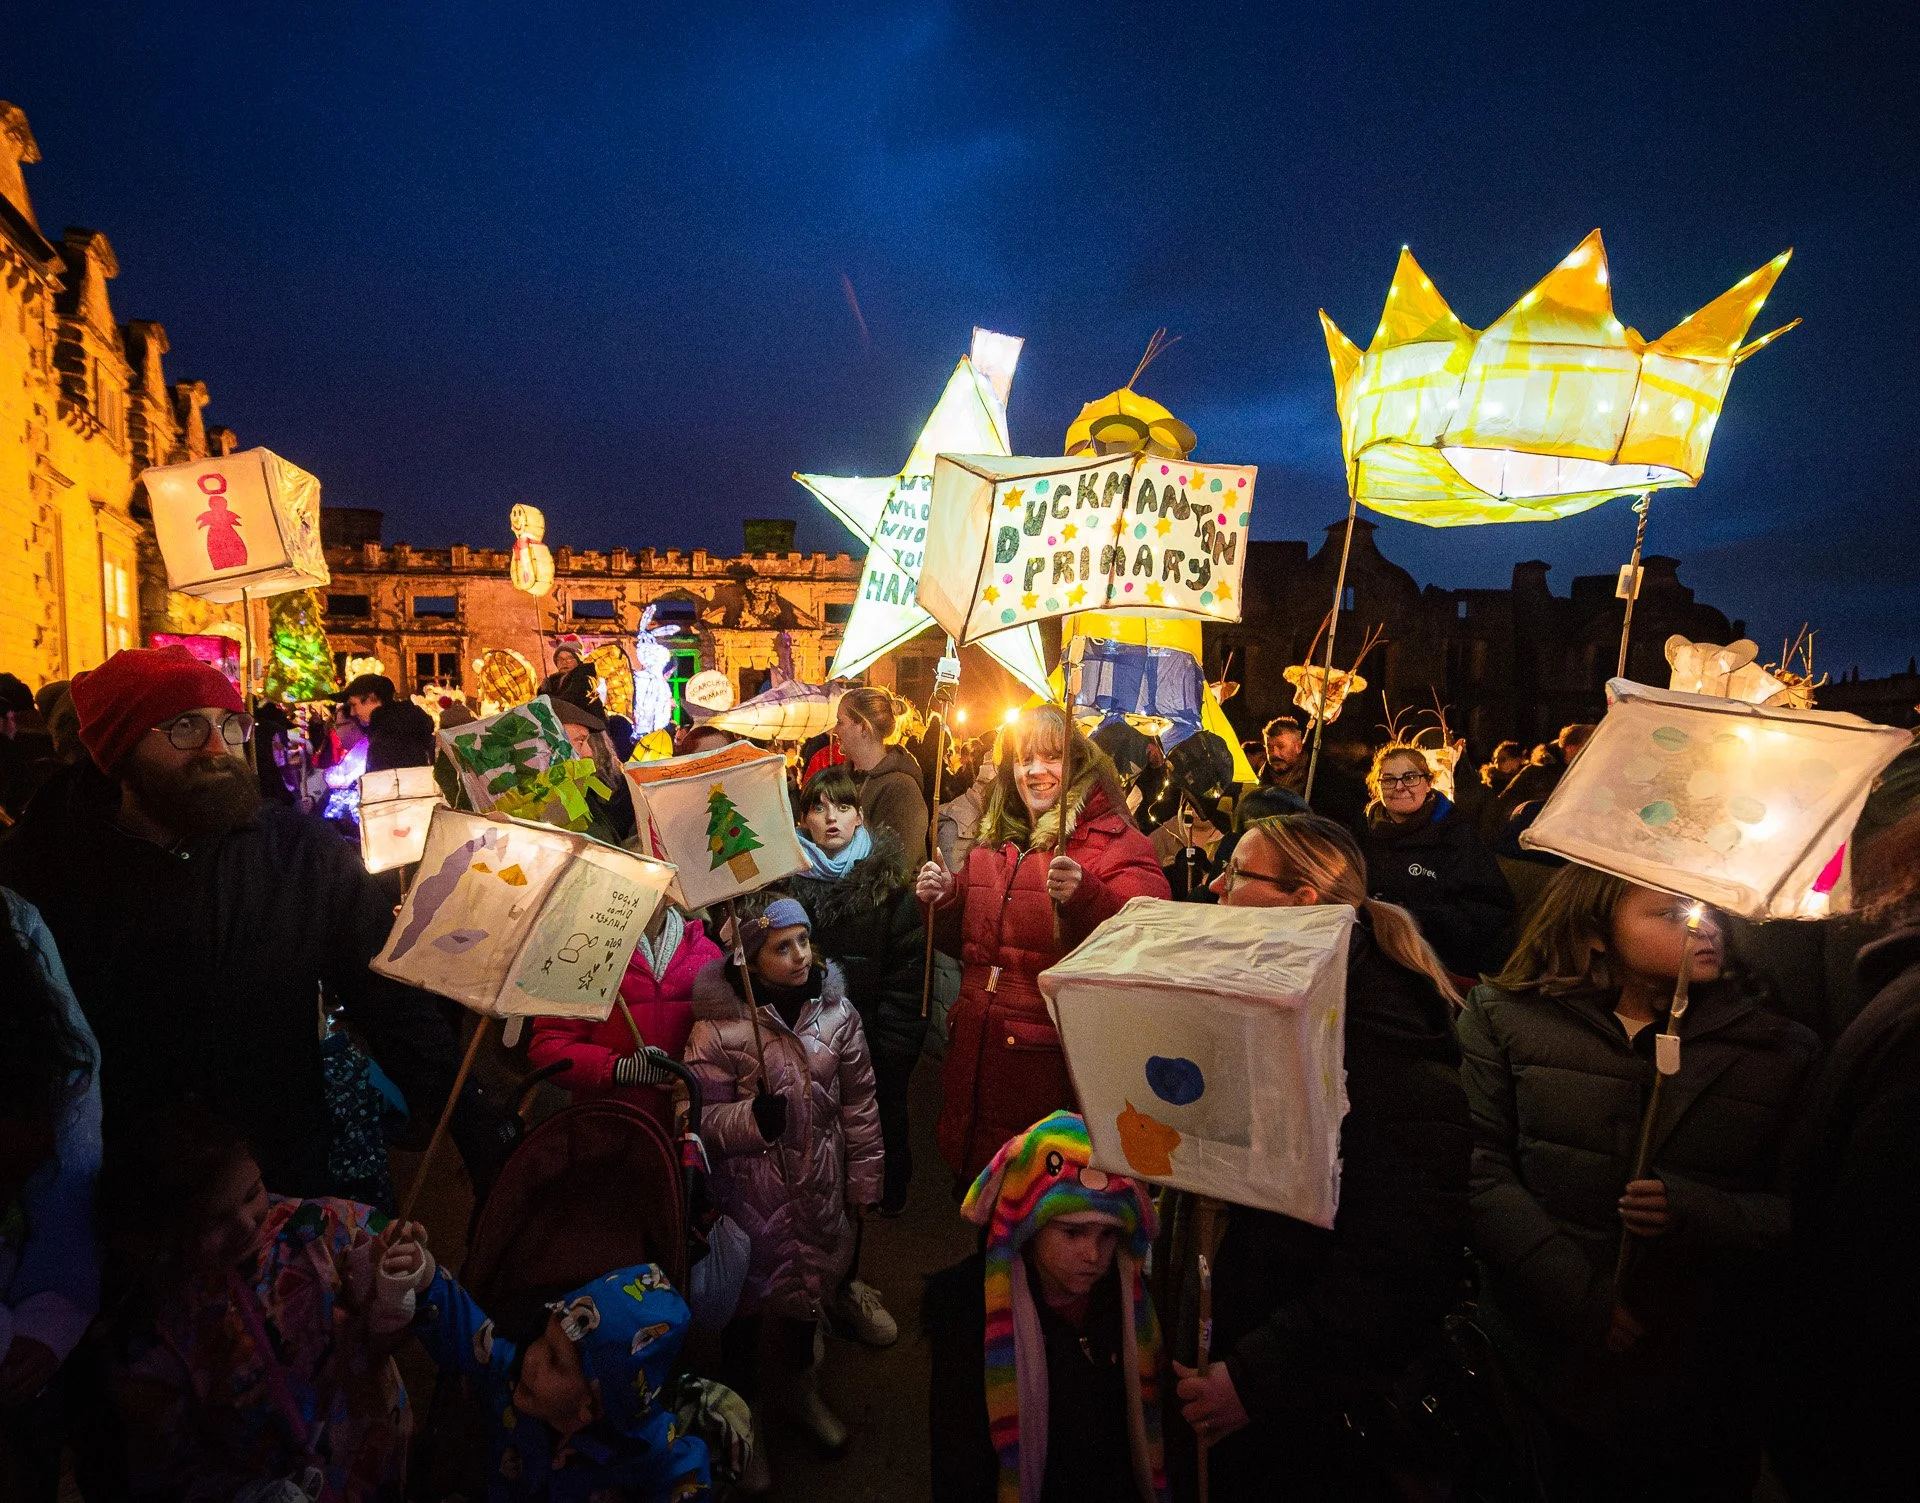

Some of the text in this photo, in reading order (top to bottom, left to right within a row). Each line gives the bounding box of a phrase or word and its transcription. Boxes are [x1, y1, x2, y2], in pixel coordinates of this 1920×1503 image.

[888, 500, 930, 521] WHO
[995, 471, 1237, 565] DUCKMANTON
[880, 519, 926, 543] WHO
[1023, 544, 1212, 592] PRIMARY
[698, 689, 728, 702] PRIMARY
